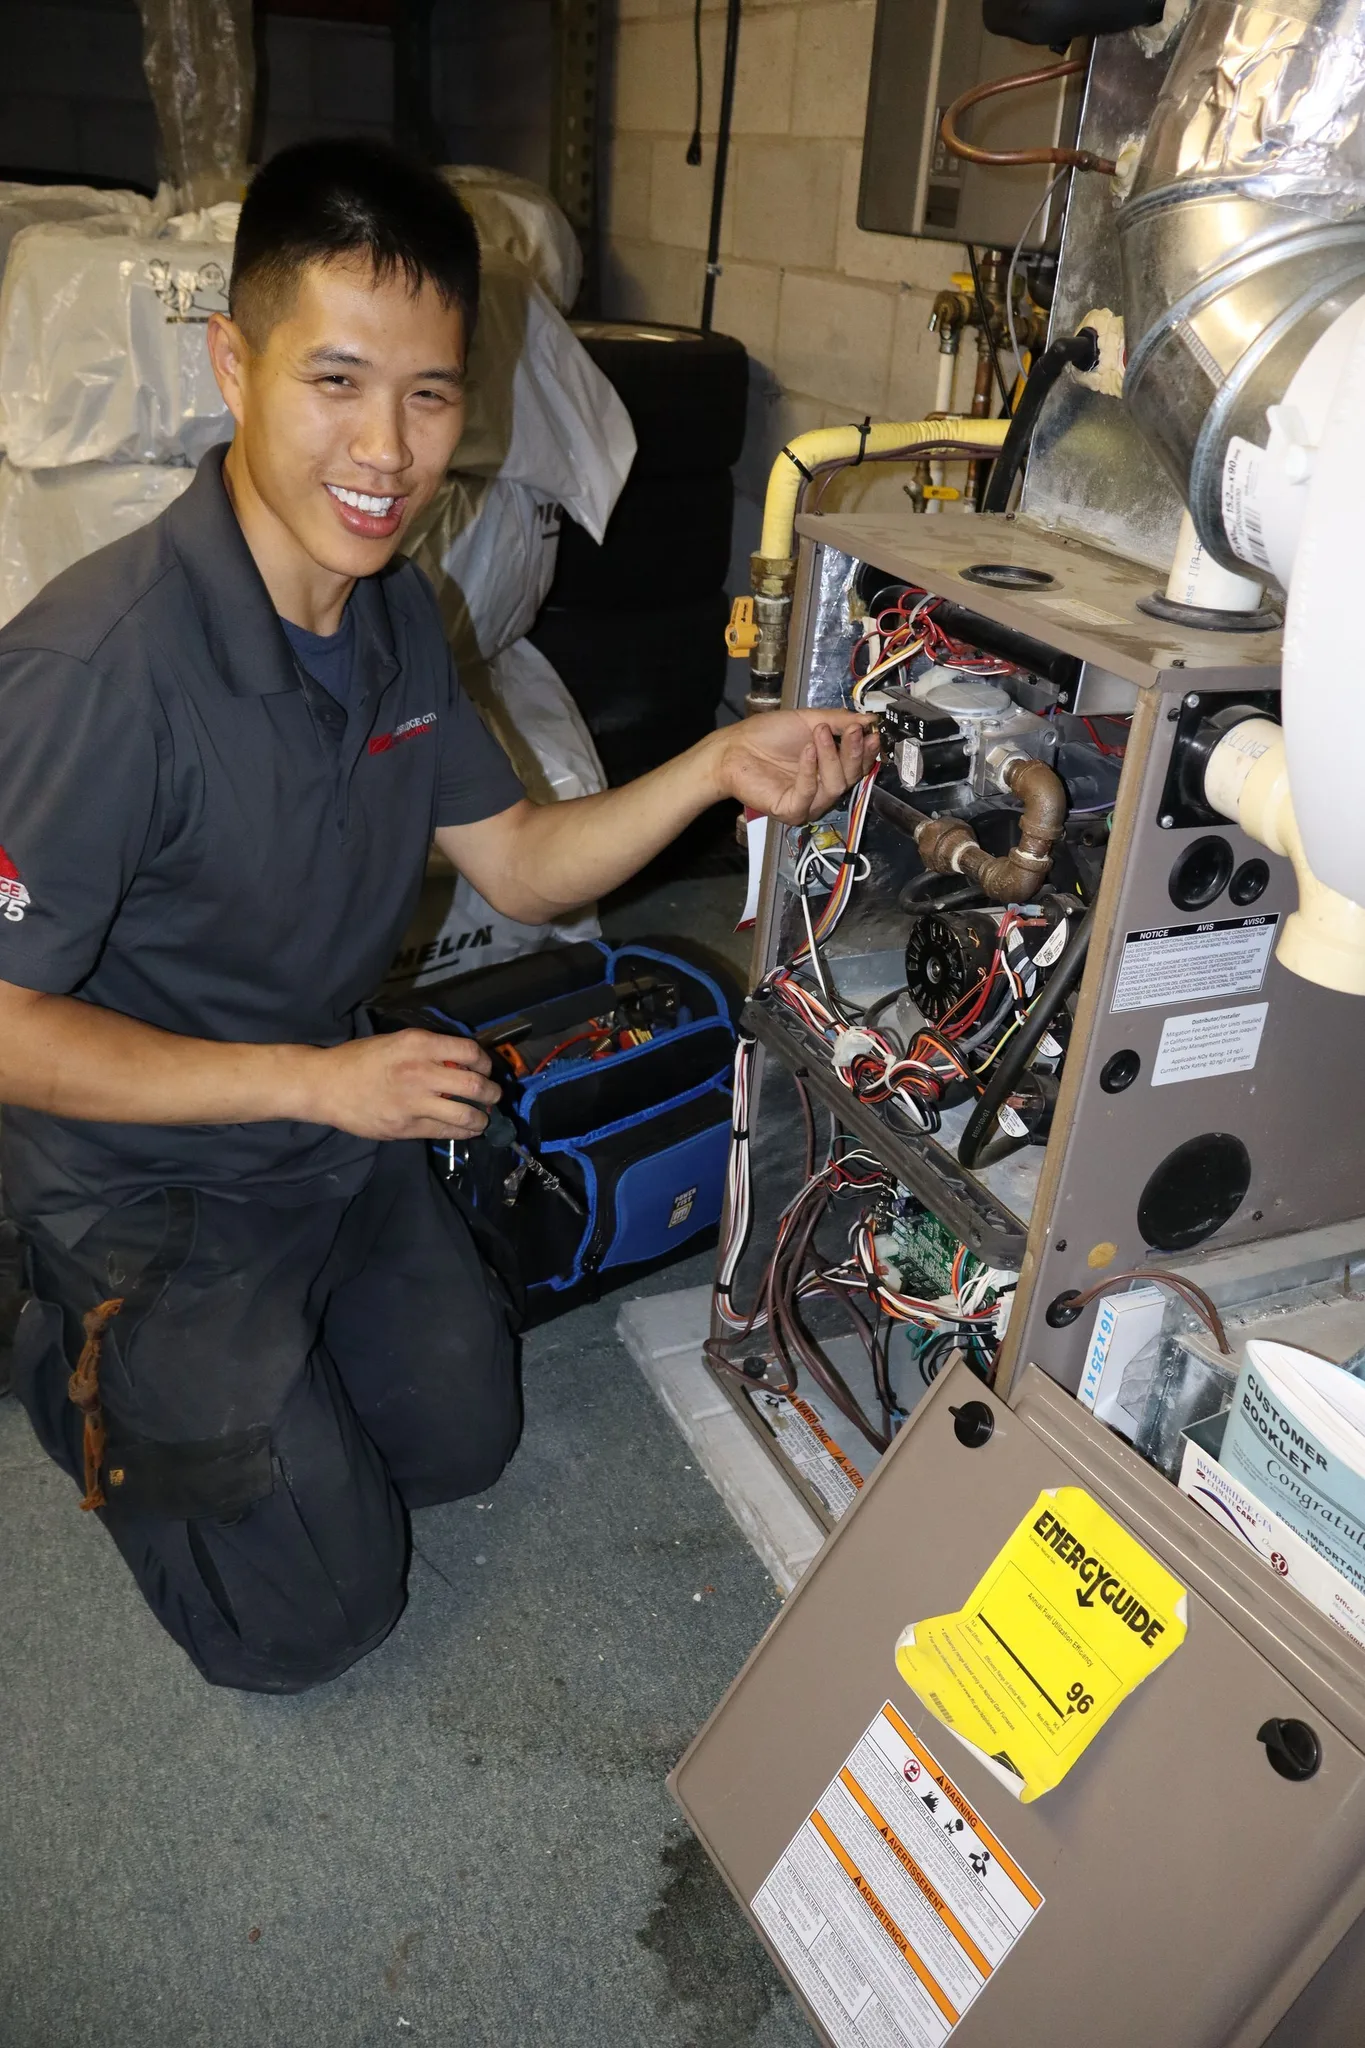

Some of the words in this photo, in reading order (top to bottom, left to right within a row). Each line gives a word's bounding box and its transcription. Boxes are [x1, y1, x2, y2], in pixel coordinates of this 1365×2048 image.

[1226, 459, 1238, 476] 90
[1139, 930, 1169, 940] NOTICE
[1196, 923, 1215, 933] AVIS
[1242, 917, 1266, 927] AVISO
[1169, 1036, 1193, 1045] California
[1170, 1045, 1188, 1053] Quality
[1189, 1039, 1221, 1050] Management
[1171, 1055, 1197, 1065] Applicable
[1160, 1066, 1180, 1075] Current
[1097, 1333, 1106, 1346] x
[1101, 1310, 1114, 1334] 16
[1087, 1372, 1096, 1385] x
[1091, 1346, 1105, 1373] 25
[1085, 1388, 1094, 1400] 1
[1243, 1392, 1312, 1475] BOOKLET
[1247, 1374, 1328, 1472] CUSTOMER
[1196, 1458, 1254, 1515] WOODBRIDGE
[1255, 1512, 1273, 1533] GTA
[1207, 1478, 1257, 1528] CLIMATECARE
[1032, 1509, 1165, 1648] ENERGYGUIDE
[1028, 1593, 1044, 1610] Annual
[1041, 1608, 1054, 1622] Fuel
[1051, 1619, 1074, 1644] Utilization
[1071, 1642, 1094, 1667] Efficiency
[941, 1631, 958, 1652] Efficiency
[972, 1673, 982, 1685] only
[983, 1688, 997, 1705] Natural
[994, 1702, 1003, 1713] Gas
[1066, 1681, 1095, 1714] 96
[943, 1782, 978, 1828] WARNING
[862, 1814, 880, 1839] DANGER
[878, 1836, 885, 1848] DE
[920, 1894, 927, 1905] ET
[903, 1785, 928, 1817] EXPLOSION
[925, 1815, 936, 1829] AND
[935, 1827, 966, 1869] ASPHYXIATION
[964, 1866, 984, 1893] HAZARD
[787, 1864, 806, 1892] EXTERNAL
[805, 1891, 821, 1917] FILTERS
[889, 1836, 943, 1913] AVERTISSEMENT
[835, 1861, 851, 1884] RIESGO
[849, 1882, 857, 1894] DE
[896, 1951, 904, 1960] Y
[862, 1885, 908, 1952] ADVERTENCIA
[777, 1910, 787, 1925] FOR
[785, 1922, 808, 1959] APPLIANCES
[807, 1956, 828, 1990] INSTALLED
[826, 1987, 833, 1998] IN
[831, 1995, 841, 2010] THE
[839, 2007, 853, 2028] STATE
[851, 2026, 859, 2038] OF
[829, 1930, 847, 1955] FILTRES
[846, 1953, 867, 1987] EXTERNES
[876, 2001, 895, 2029] FILTROS
